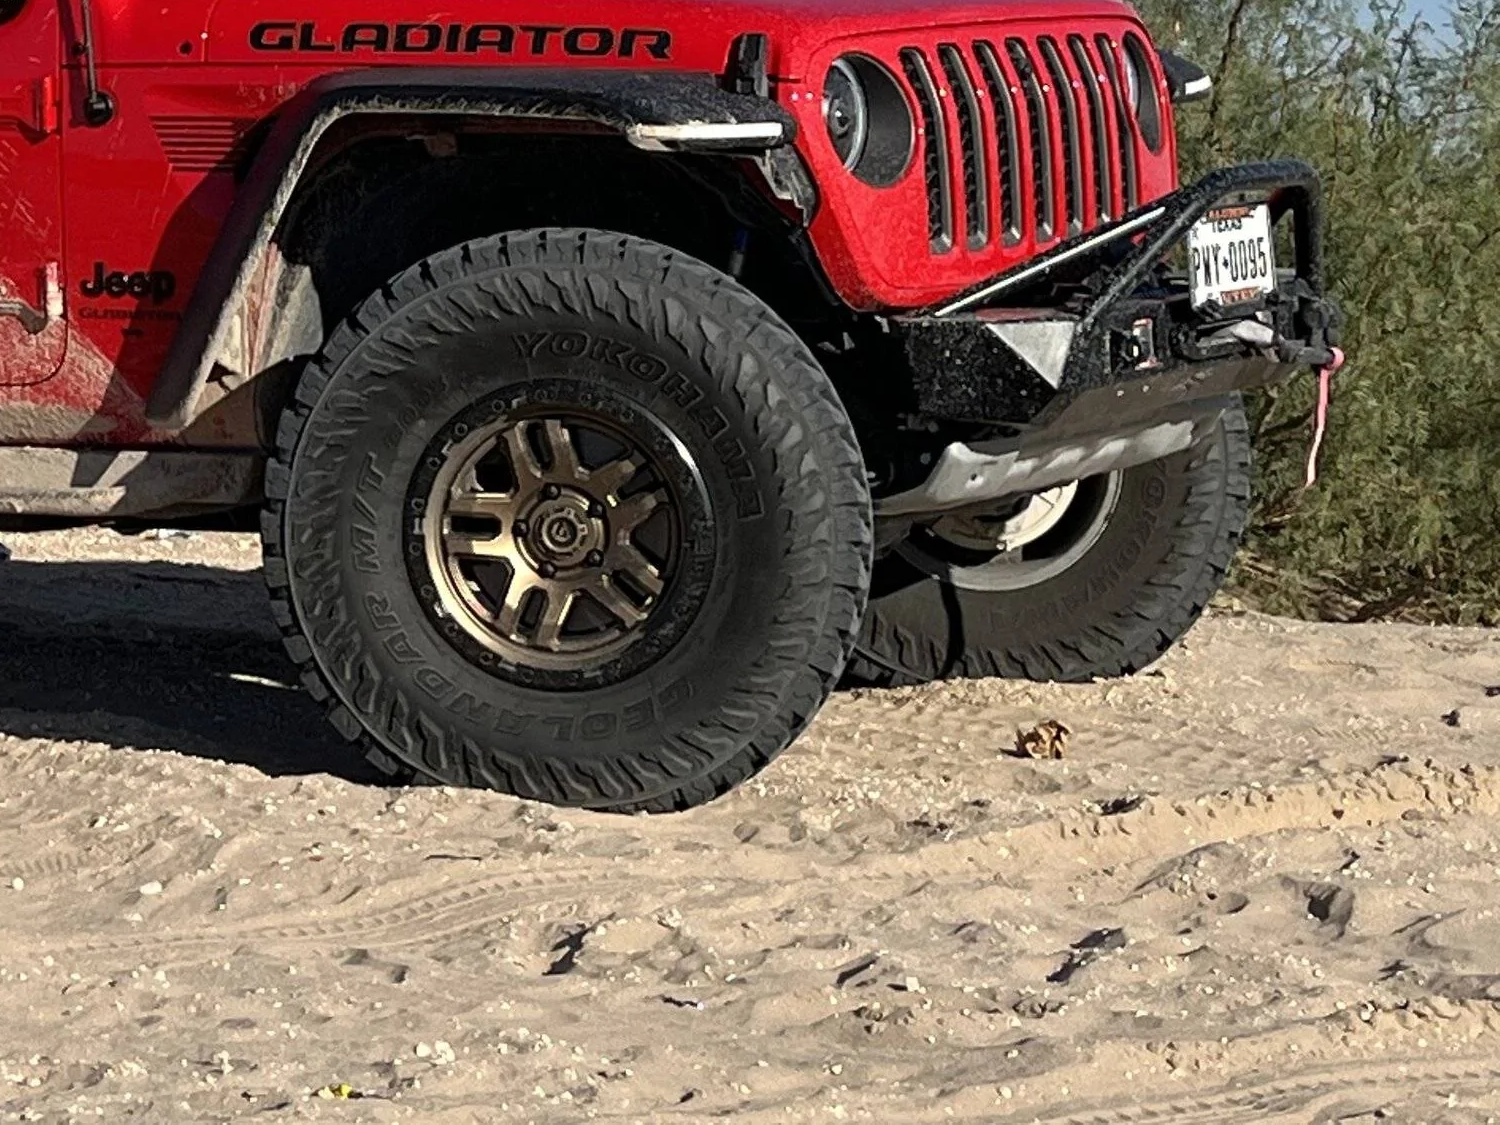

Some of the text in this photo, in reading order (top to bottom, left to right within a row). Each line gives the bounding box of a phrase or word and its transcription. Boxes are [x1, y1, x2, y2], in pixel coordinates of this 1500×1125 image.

[249, 21, 673, 60] GLADIATOR
[79, 261, 176, 305] Jeep
[511, 330, 765, 522] YOKOHAMA
[363, 590, 695, 742] GEOLANDAR
